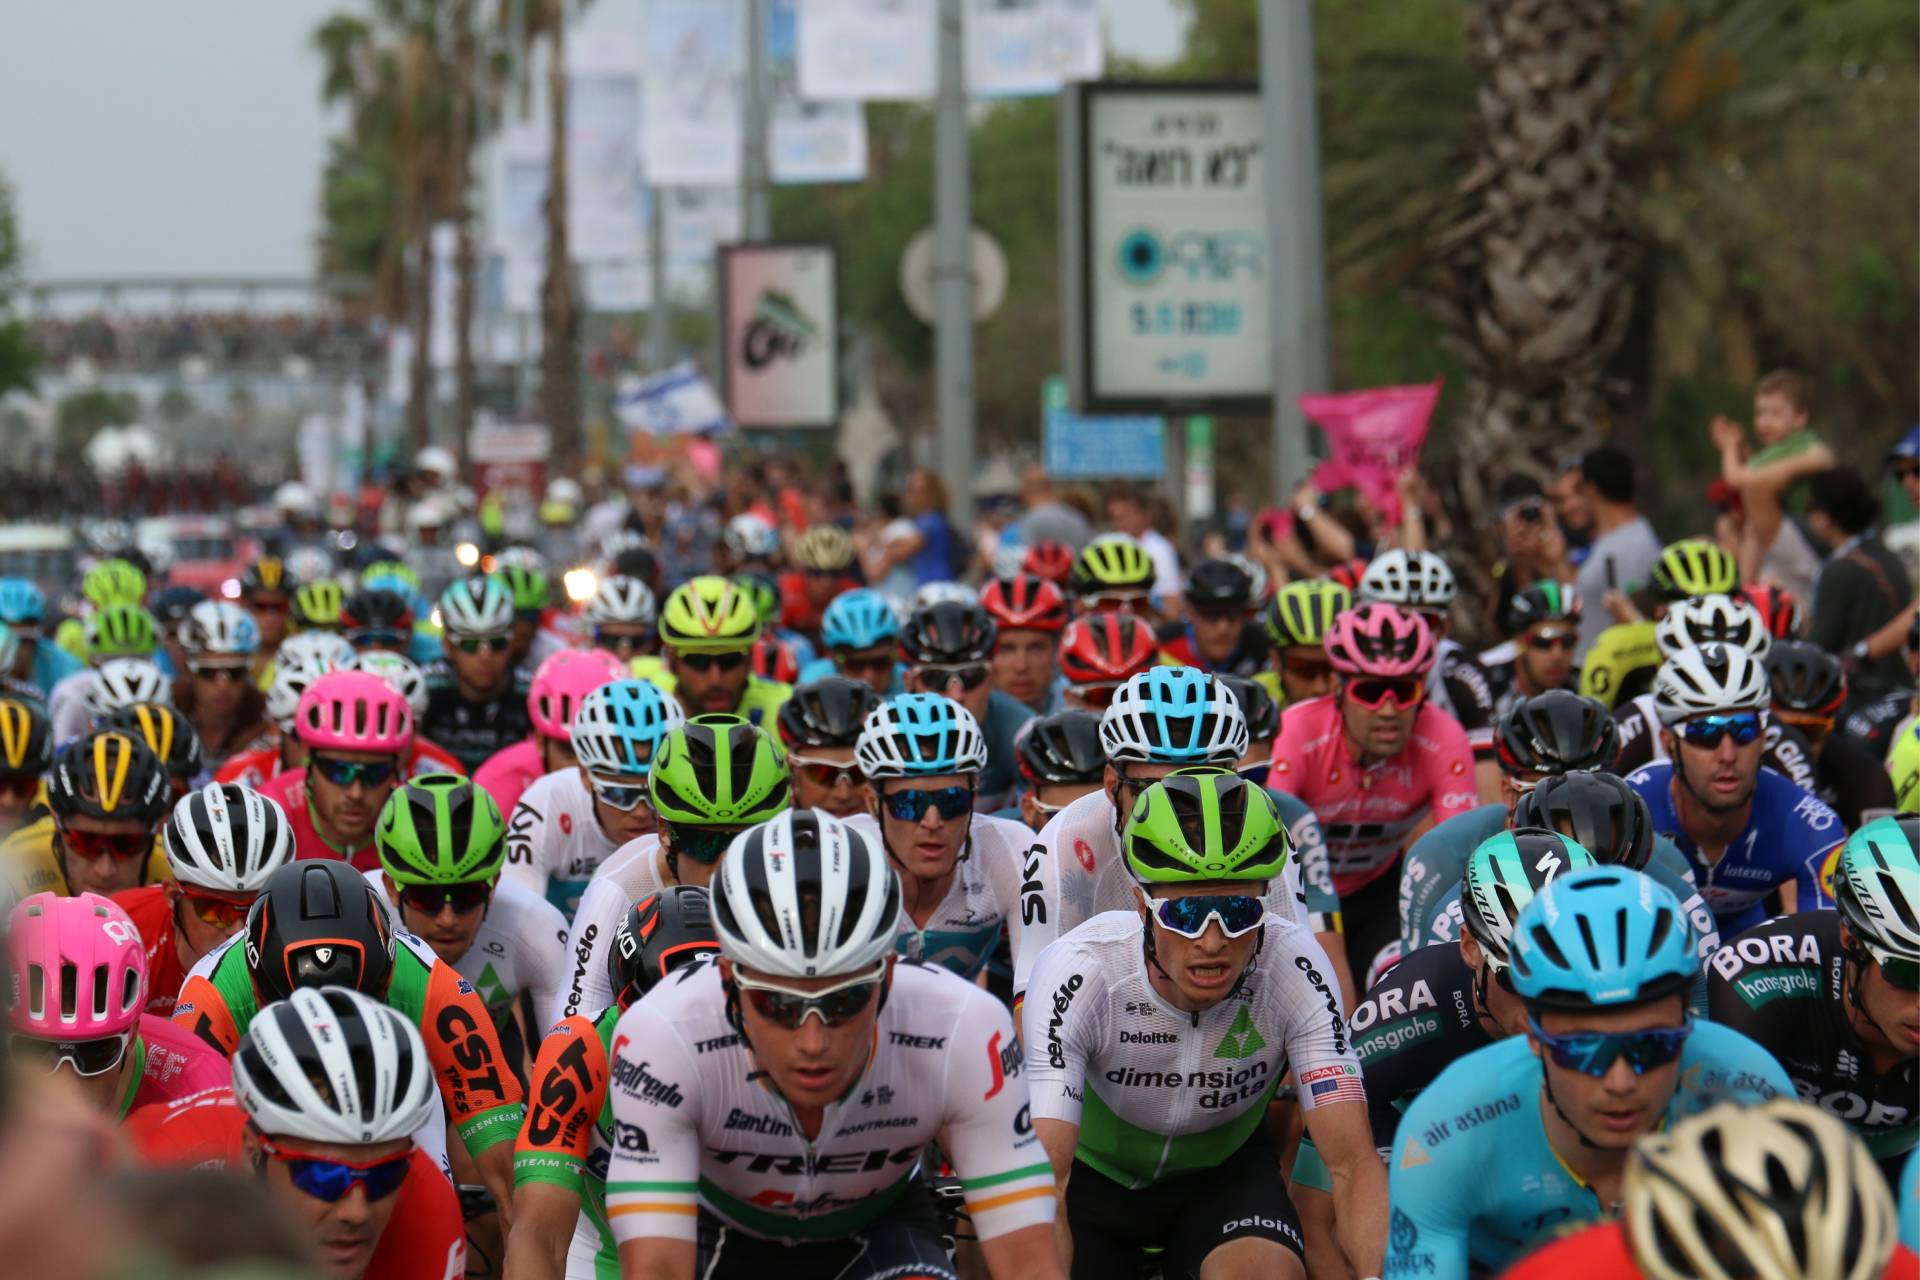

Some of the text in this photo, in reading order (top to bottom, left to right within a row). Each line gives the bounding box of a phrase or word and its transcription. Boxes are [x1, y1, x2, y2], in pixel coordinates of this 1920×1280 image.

[1774, 740, 1816, 798] GIAN
[1169, 838, 1201, 865] OAKLEY
[1230, 836, 1258, 863] OAKLEY
[564, 923, 598, 1019] cervélo
[1712, 934, 1821, 982] BORA
[1832, 956, 1842, 1000] BORA
[1048, 973, 1084, 1070] cervélo
[1344, 979, 1438, 1040] ORA
[1453, 990, 1471, 1029] BORA
[436, 1005, 505, 1101] CST
[889, 1031, 947, 1050] TREK
[1355, 1017, 1437, 1060] ansgrohe
[444, 1066, 472, 1114] TIRES
[529, 1037, 593, 1147] CST
[1106, 1060, 1267, 1089] dimension
[1199, 1079, 1267, 1109] data
[1302, 1067, 1344, 1084] SPAR
[1704, 1070, 1731, 1089] air
[561, 1107, 588, 1149] TIRES
[835, 1116, 918, 1138] BONTRAGER
[1423, 1093, 1521, 1147] air astana
[704, 1145, 923, 1177] TREK
